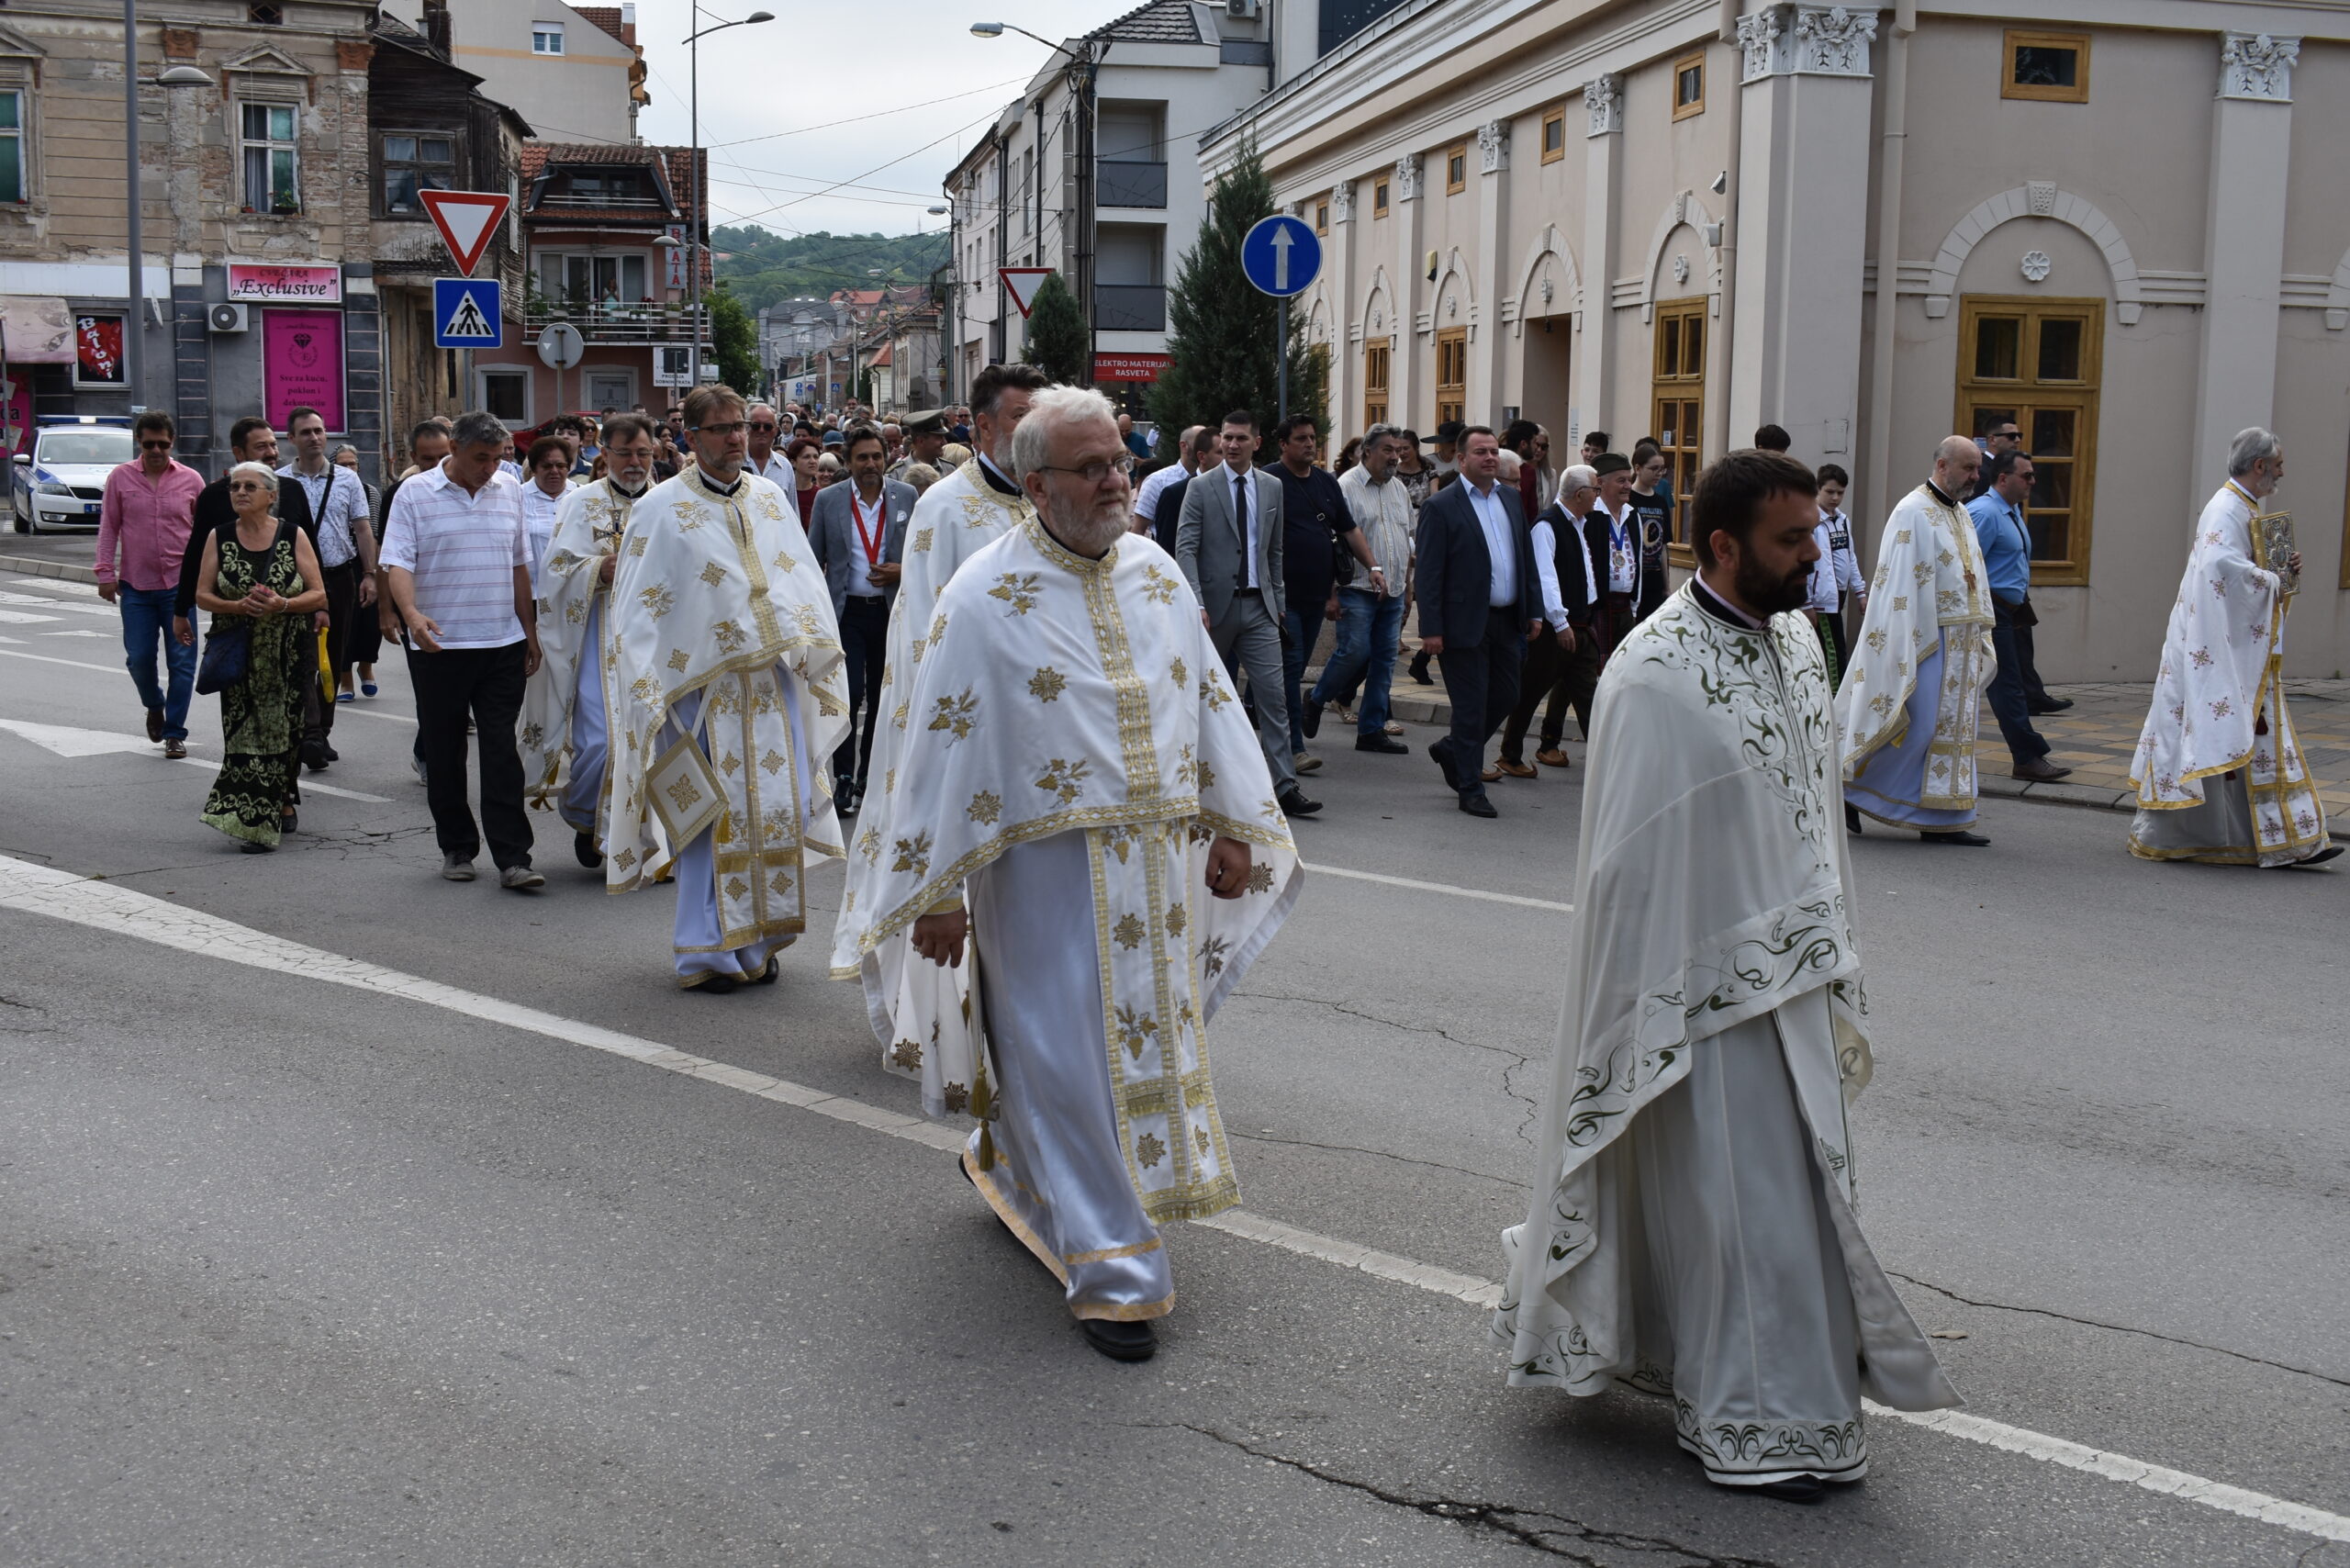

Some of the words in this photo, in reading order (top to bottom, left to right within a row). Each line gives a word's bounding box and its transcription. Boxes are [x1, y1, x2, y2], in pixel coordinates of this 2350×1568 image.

[77, 317, 113, 379] Baloni
[1094, 359, 1128, 367] ELEKTRO
[287, 386, 317, 396] poklon
